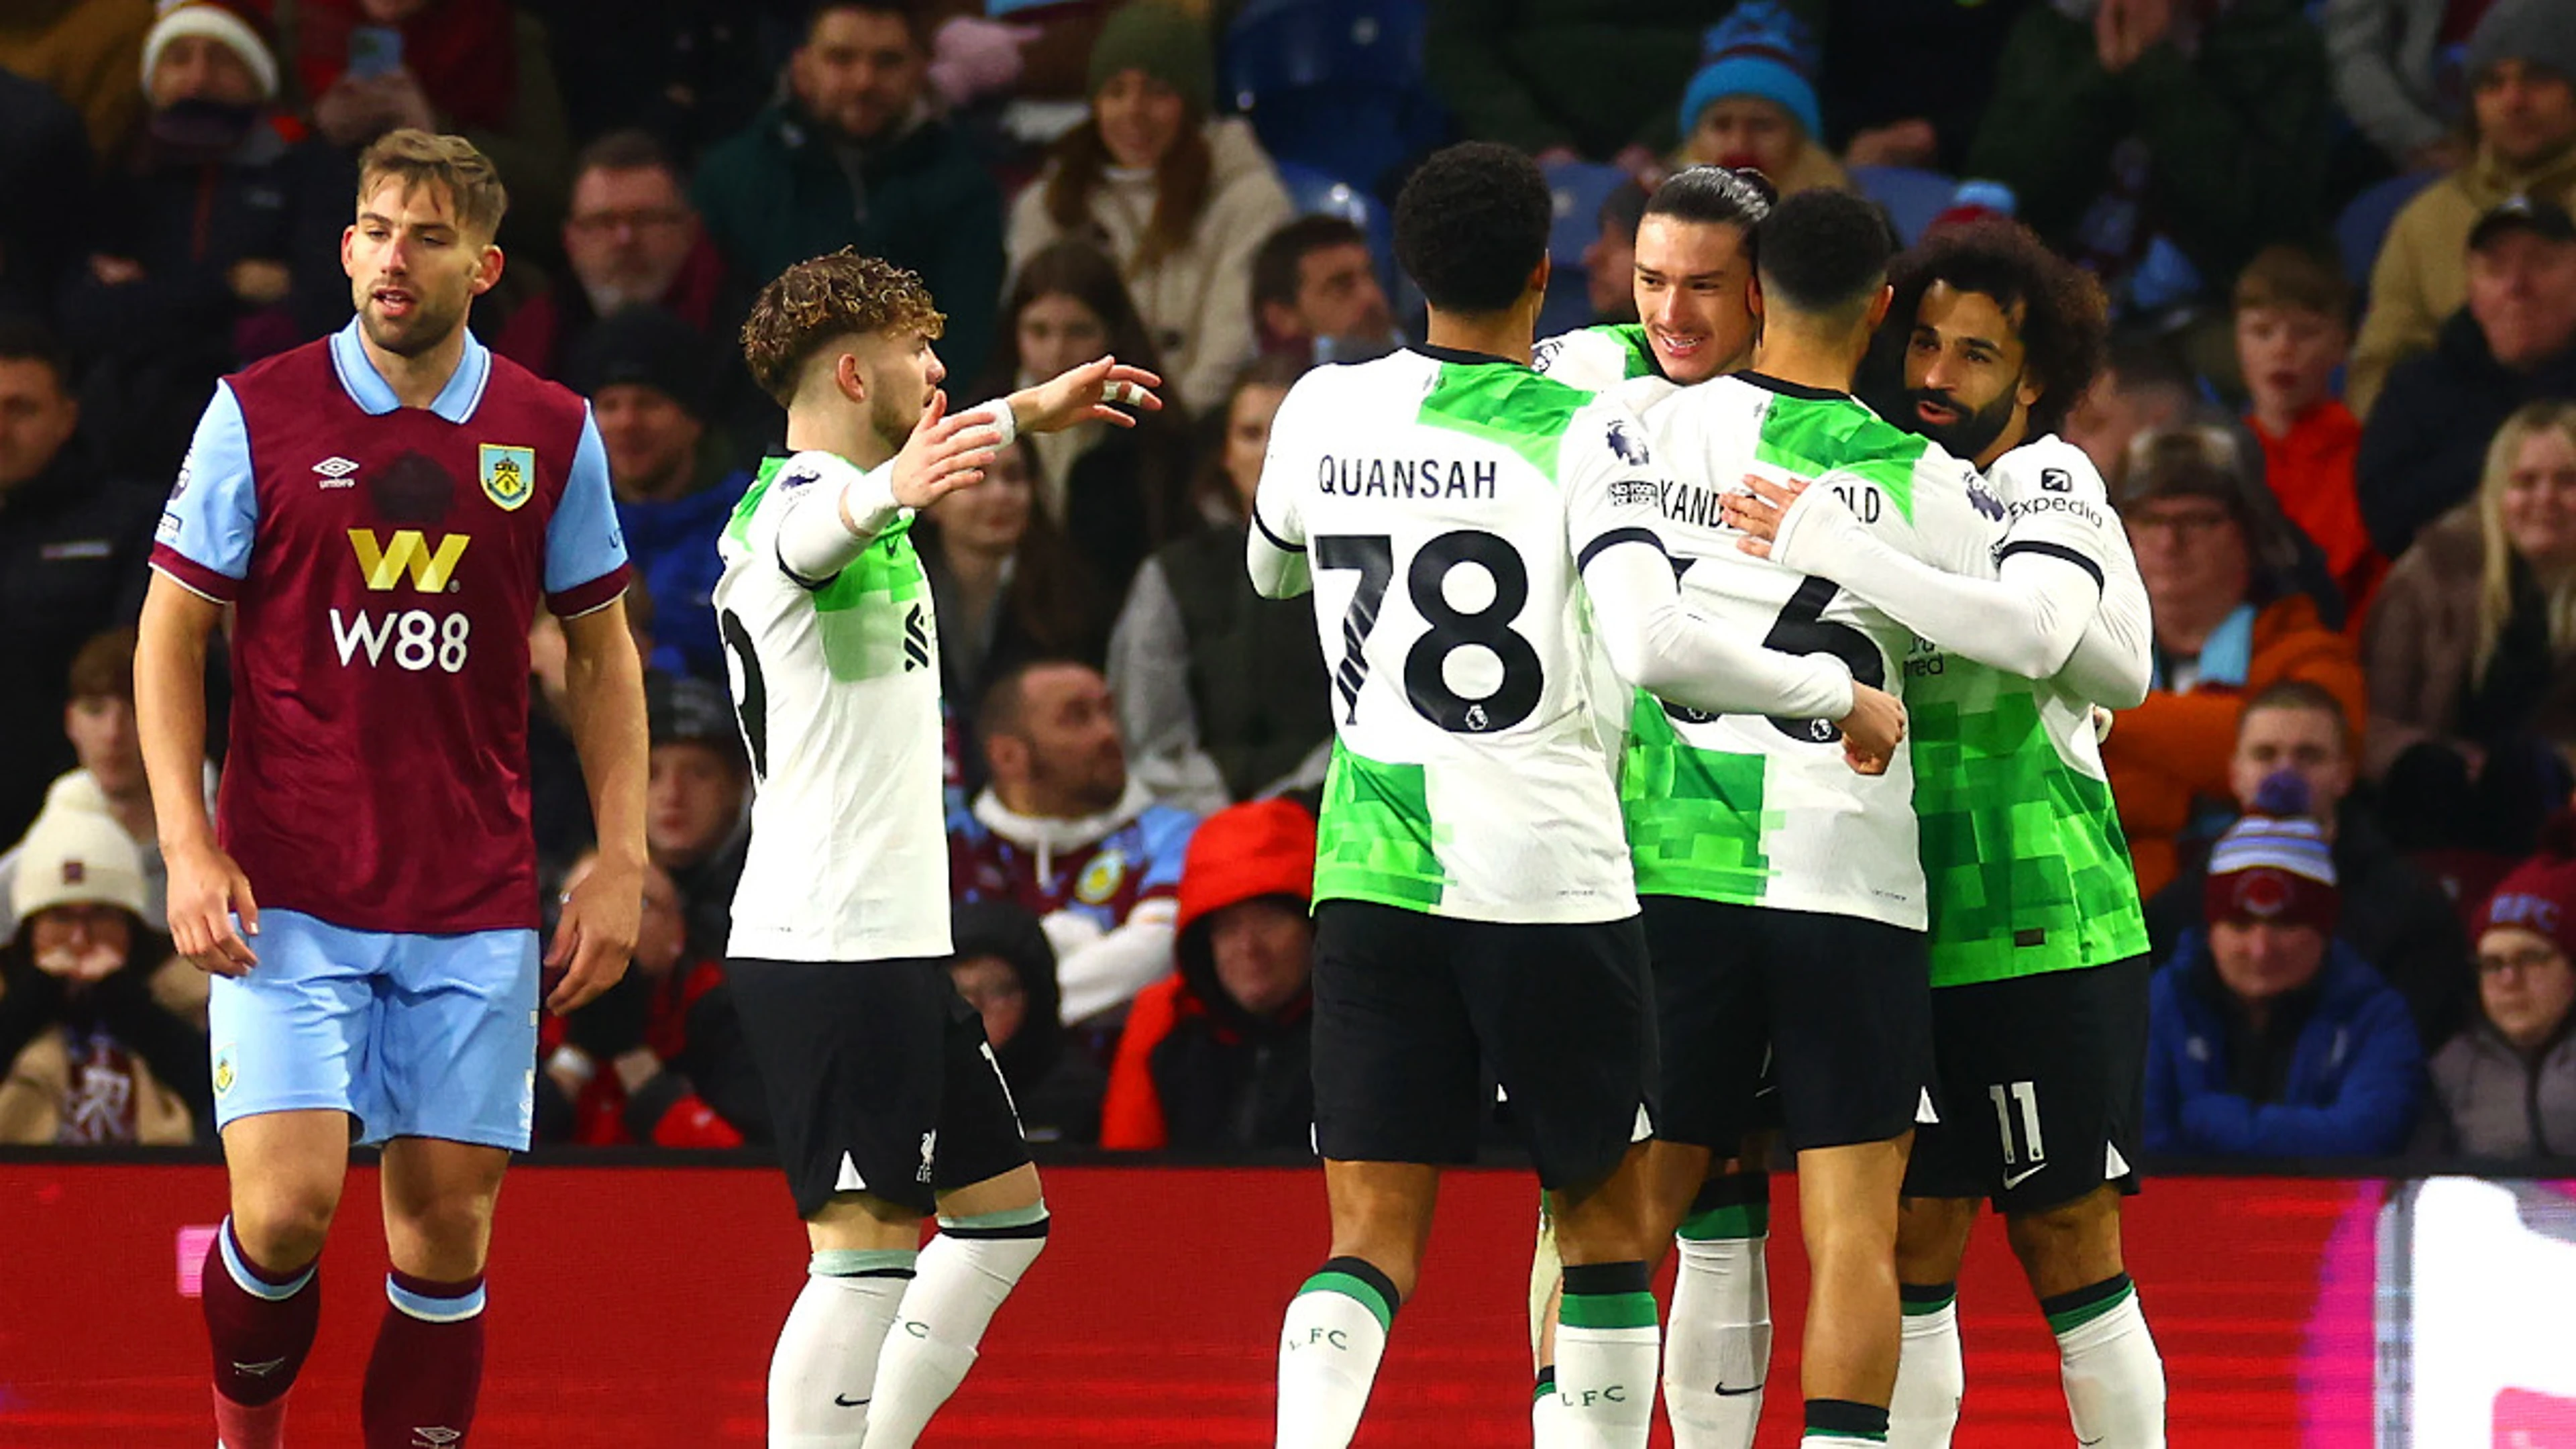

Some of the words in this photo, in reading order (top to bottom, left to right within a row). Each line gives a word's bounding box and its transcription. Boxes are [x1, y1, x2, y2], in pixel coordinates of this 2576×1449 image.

[1319, 455, 1497, 499] QUANSAH
[330, 609, 470, 673] W88
[1313, 529, 1544, 733] 78
[1989, 1081, 2045, 1165] 11
[1289, 1327, 1347, 1352] LFC
[1561, 1385, 1626, 1407] LFC
